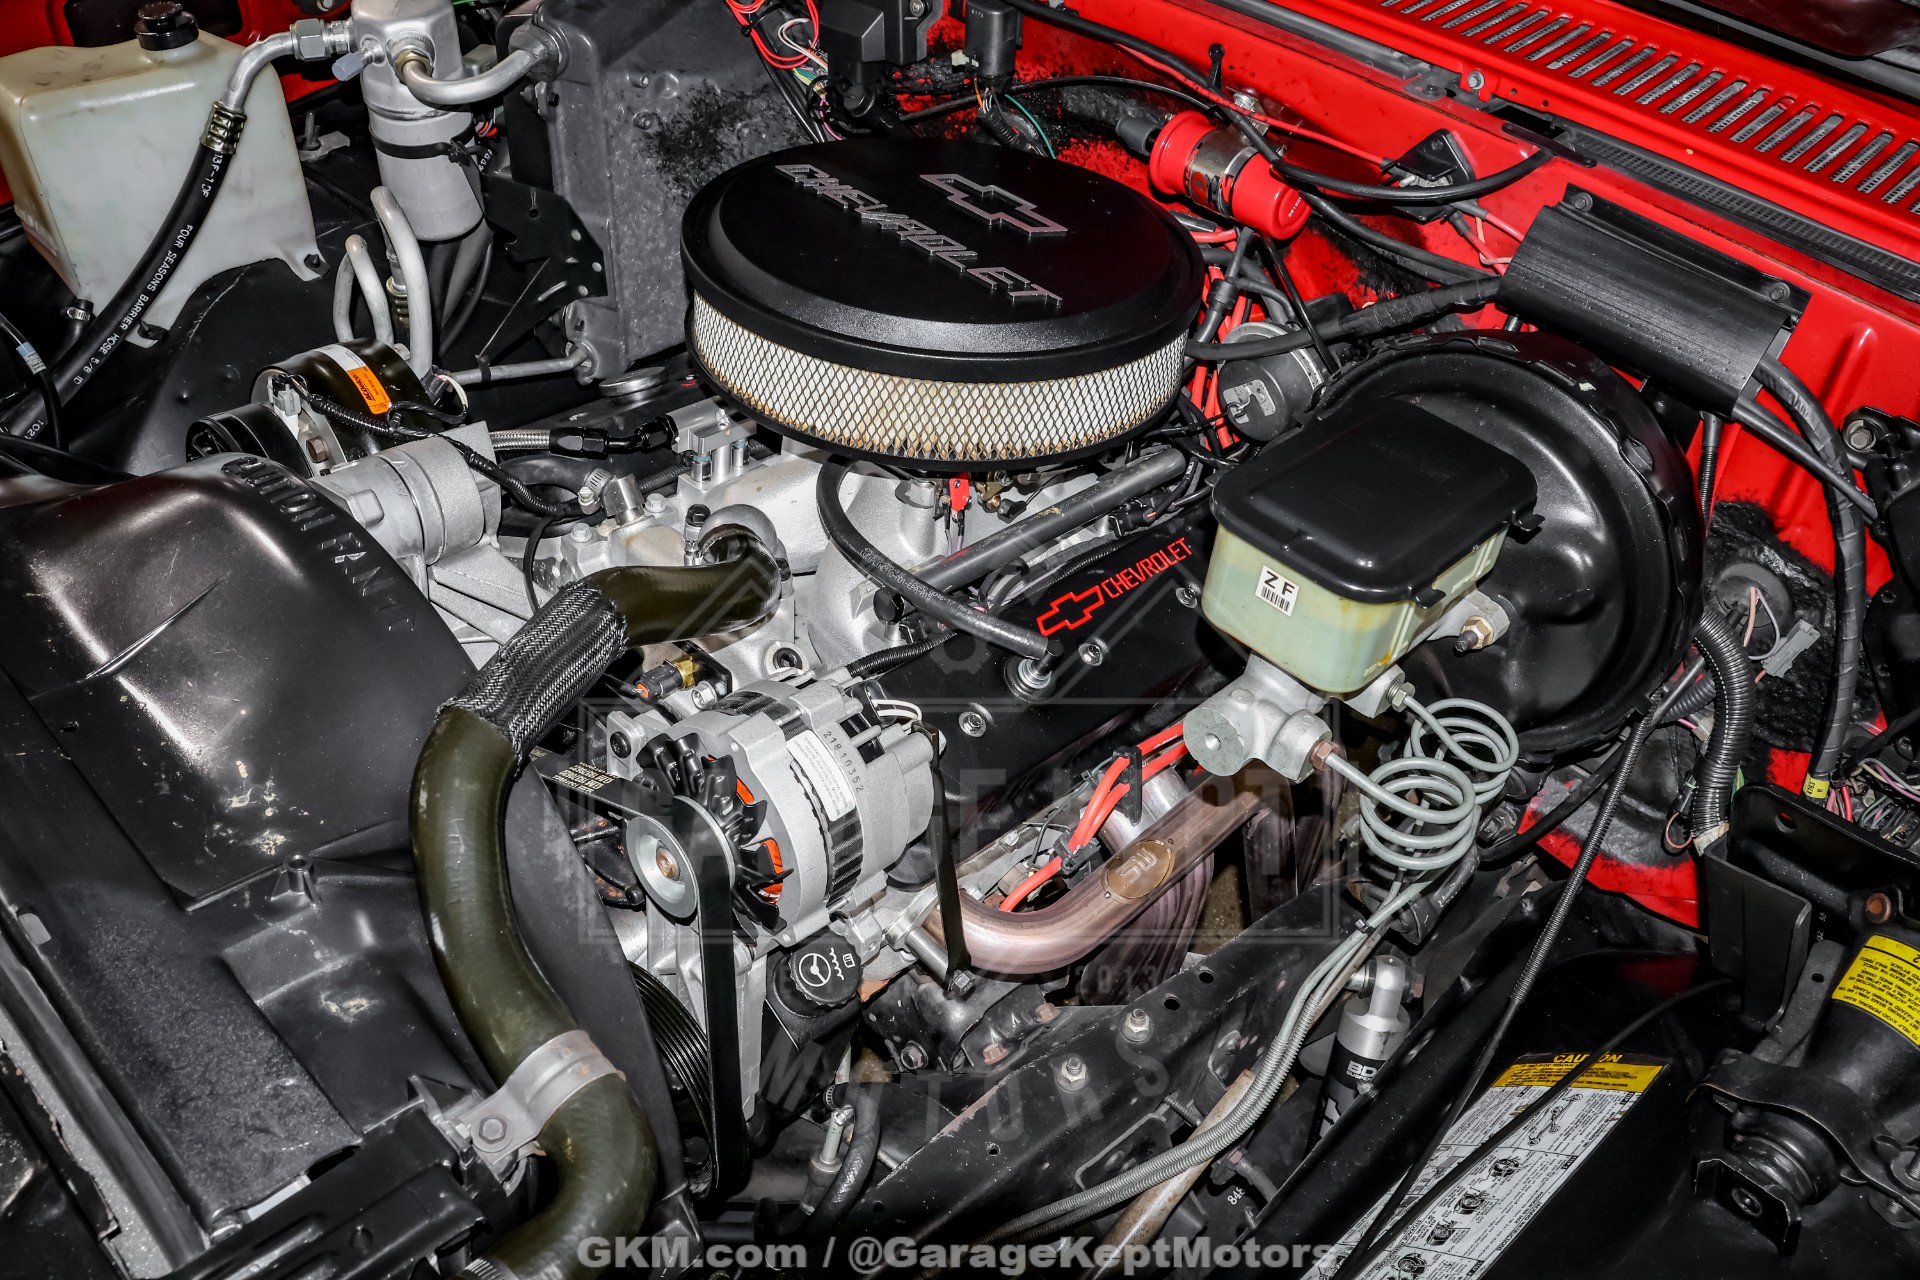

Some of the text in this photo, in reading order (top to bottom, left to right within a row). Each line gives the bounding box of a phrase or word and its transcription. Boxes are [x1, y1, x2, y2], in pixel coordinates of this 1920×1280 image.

[173, 224, 194, 249] FOUR
[774, 163, 1063, 307] CHEVROLET
[146, 250, 177, 292] SEASONS
[119, 293, 150, 331] BARRIER
[98, 332, 120, 355] HOSE
[318, 532, 400, 598] FAN
[1101, 537, 1193, 599] CHEVROLET
[1888, 971, 1912, 987] BENEATH
[1884, 990, 1907, 1005] JACKING
[1891, 988, 1907, 999] ONLY
[1893, 983, 1914, 998] DURING
[1857, 999, 1882, 1015] PERSONAL
[1869, 997, 1886, 1008] BRAKE
[1870, 992, 1893, 1006] WARNING
[1881, 1011, 1898, 1024] AVOID
[1886, 1006, 1909, 1022] PARKING
[1893, 1004, 1914, 1020] HAZARD
[1908, 1021, 1919, 1030] SET
[1553, 1053, 1624, 1063] CAUON
